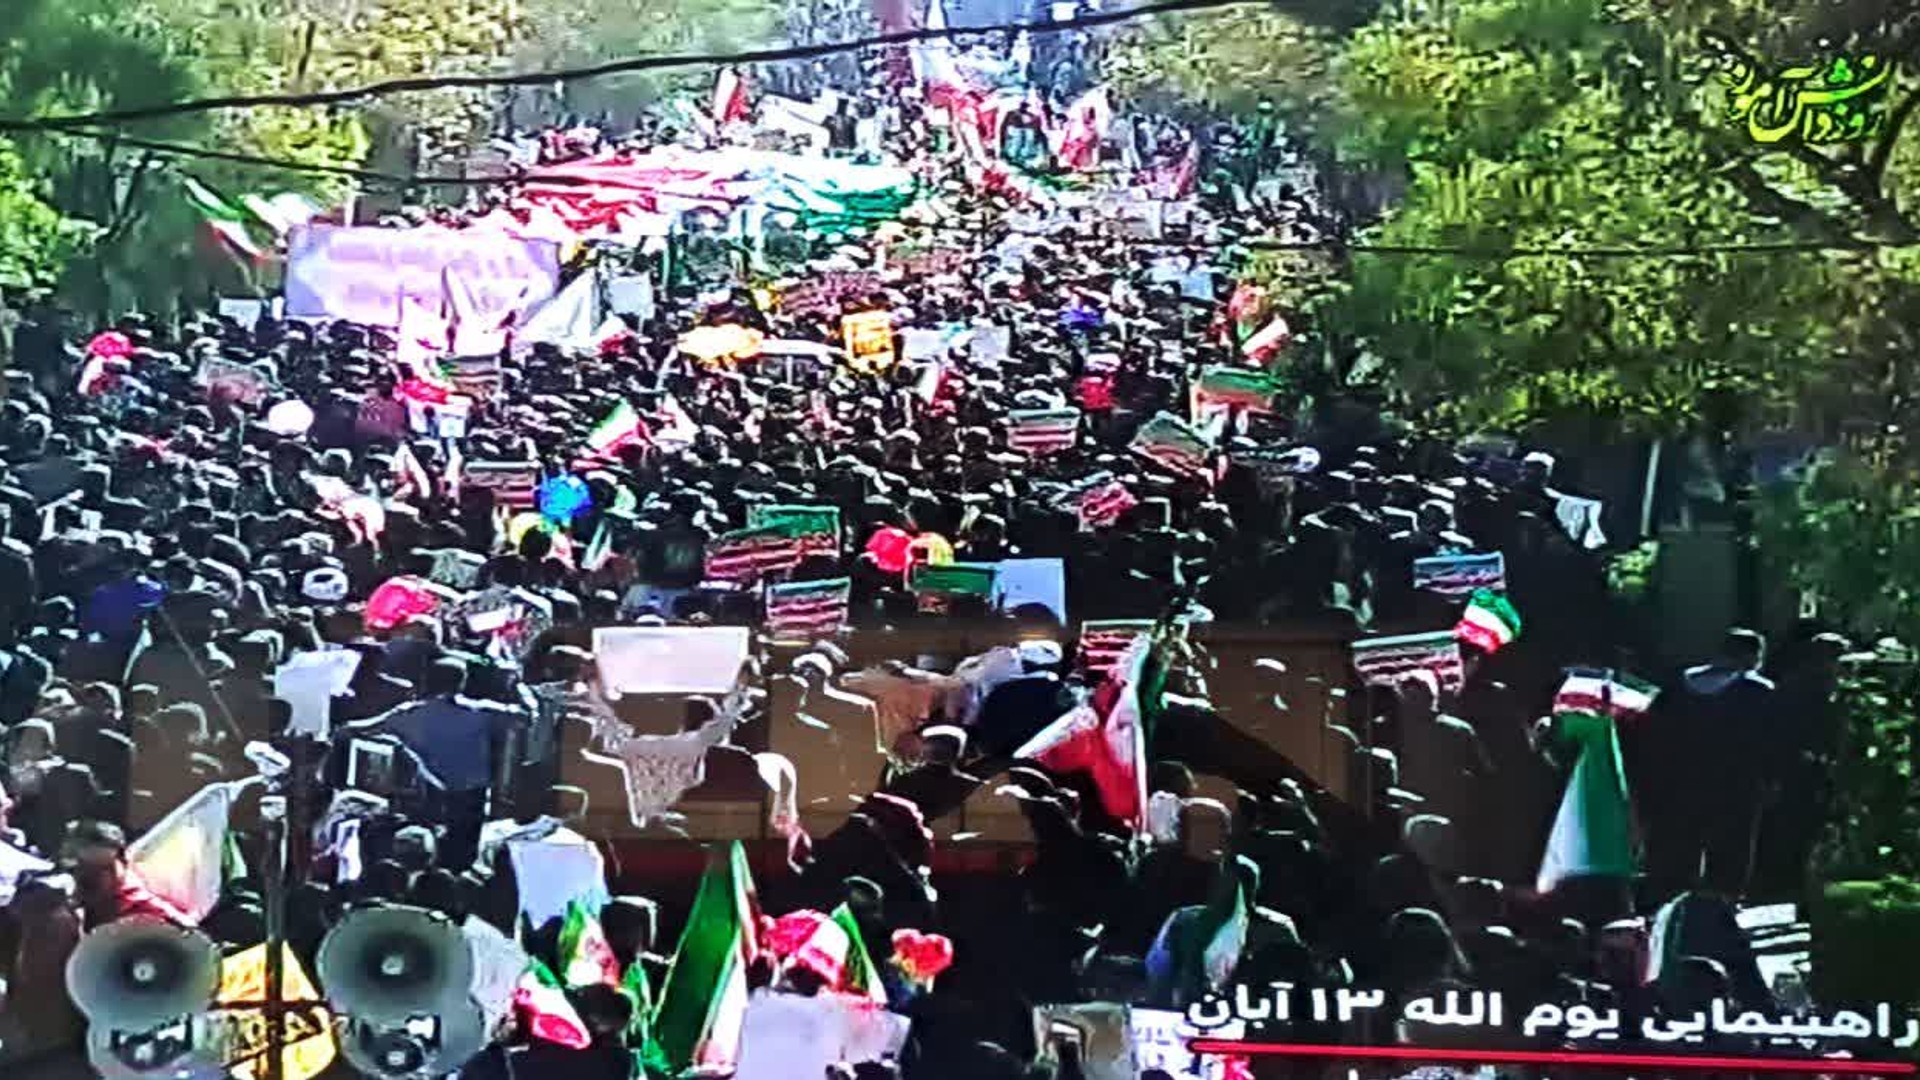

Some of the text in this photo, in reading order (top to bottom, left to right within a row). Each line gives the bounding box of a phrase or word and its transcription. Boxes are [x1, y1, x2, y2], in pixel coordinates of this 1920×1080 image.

[1188, 981, 1919, 1049] راهپیمایی یوم الله ۱۳ آبان
